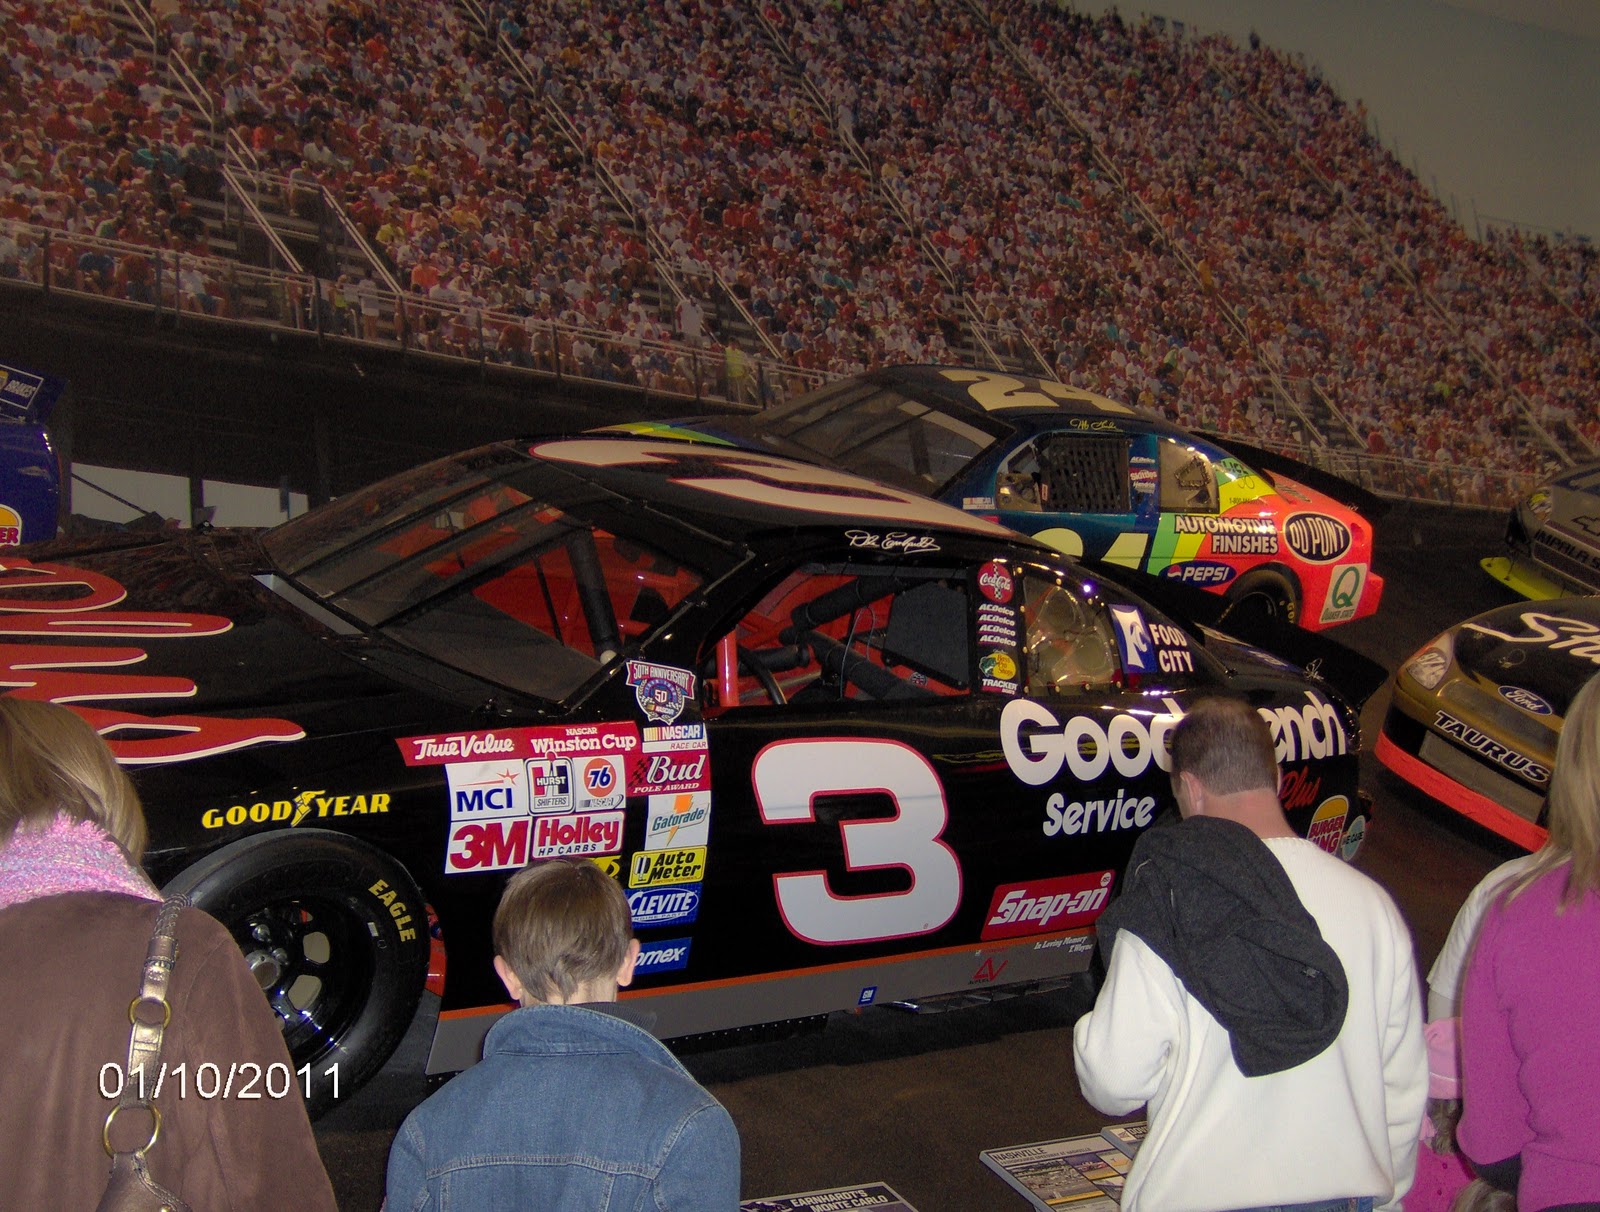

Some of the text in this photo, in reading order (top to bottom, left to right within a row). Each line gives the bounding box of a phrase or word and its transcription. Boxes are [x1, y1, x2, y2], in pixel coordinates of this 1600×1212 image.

[1176, 516, 1278, 534] AUTOMOTIVE
[1212, 536, 1279, 554] FINISHES
[1182, 566, 1230, 581] PEPSI
[978, 604, 1015, 616] ACDelco
[978, 614, 1015, 626] ACDelco
[979, 625, 1016, 636] ACDelco
[1148, 623, 1188, 647] FOOD
[980, 635, 1017, 647] ACDelco
[1159, 649, 1194, 672] CITY
[982, 679, 1018, 690] TRACKER
[654, 690, 668, 703] 50
[1505, 689, 1542, 711] Ford
[565, 727, 598, 736] NASCAR
[661, 725, 702, 740] NASCAR
[530, 734, 637, 754] Winston Cup
[692, 741, 707, 749] CAR
[1434, 709, 1550, 783] TAURUS
[588, 766, 611, 789] 76
[646, 755, 706, 784] Bud
[536, 776, 567, 787] HURST
[633, 782, 699, 794] POLE AWARD
[456, 788, 513, 813] MCI
[537, 797, 568, 807] SHIFTERS
[652, 806, 705, 832] Gatorade
[1042, 788, 1156, 837] Service
[537, 816, 620, 851] Holley
[1309, 815, 1346, 838] BURGER
[451, 820, 530, 870] 3M
[558, 843, 597, 855] CARBS
[751, 736, 963, 946] 3
[1311, 832, 1340, 854] ING
[654, 852, 696, 867] Auto
[650, 865, 702, 880] Meter
[368, 878, 417, 943] EAGLE
[628, 890, 695, 916] CLEVITE
[988, 887, 1108, 926] Snap-on
[992, 1147, 1047, 1162] NASHVILLE
[790, 1189, 868, 1208] EARNHARDT'S
[810, 1195, 889, 1212] MONTE CARLO
